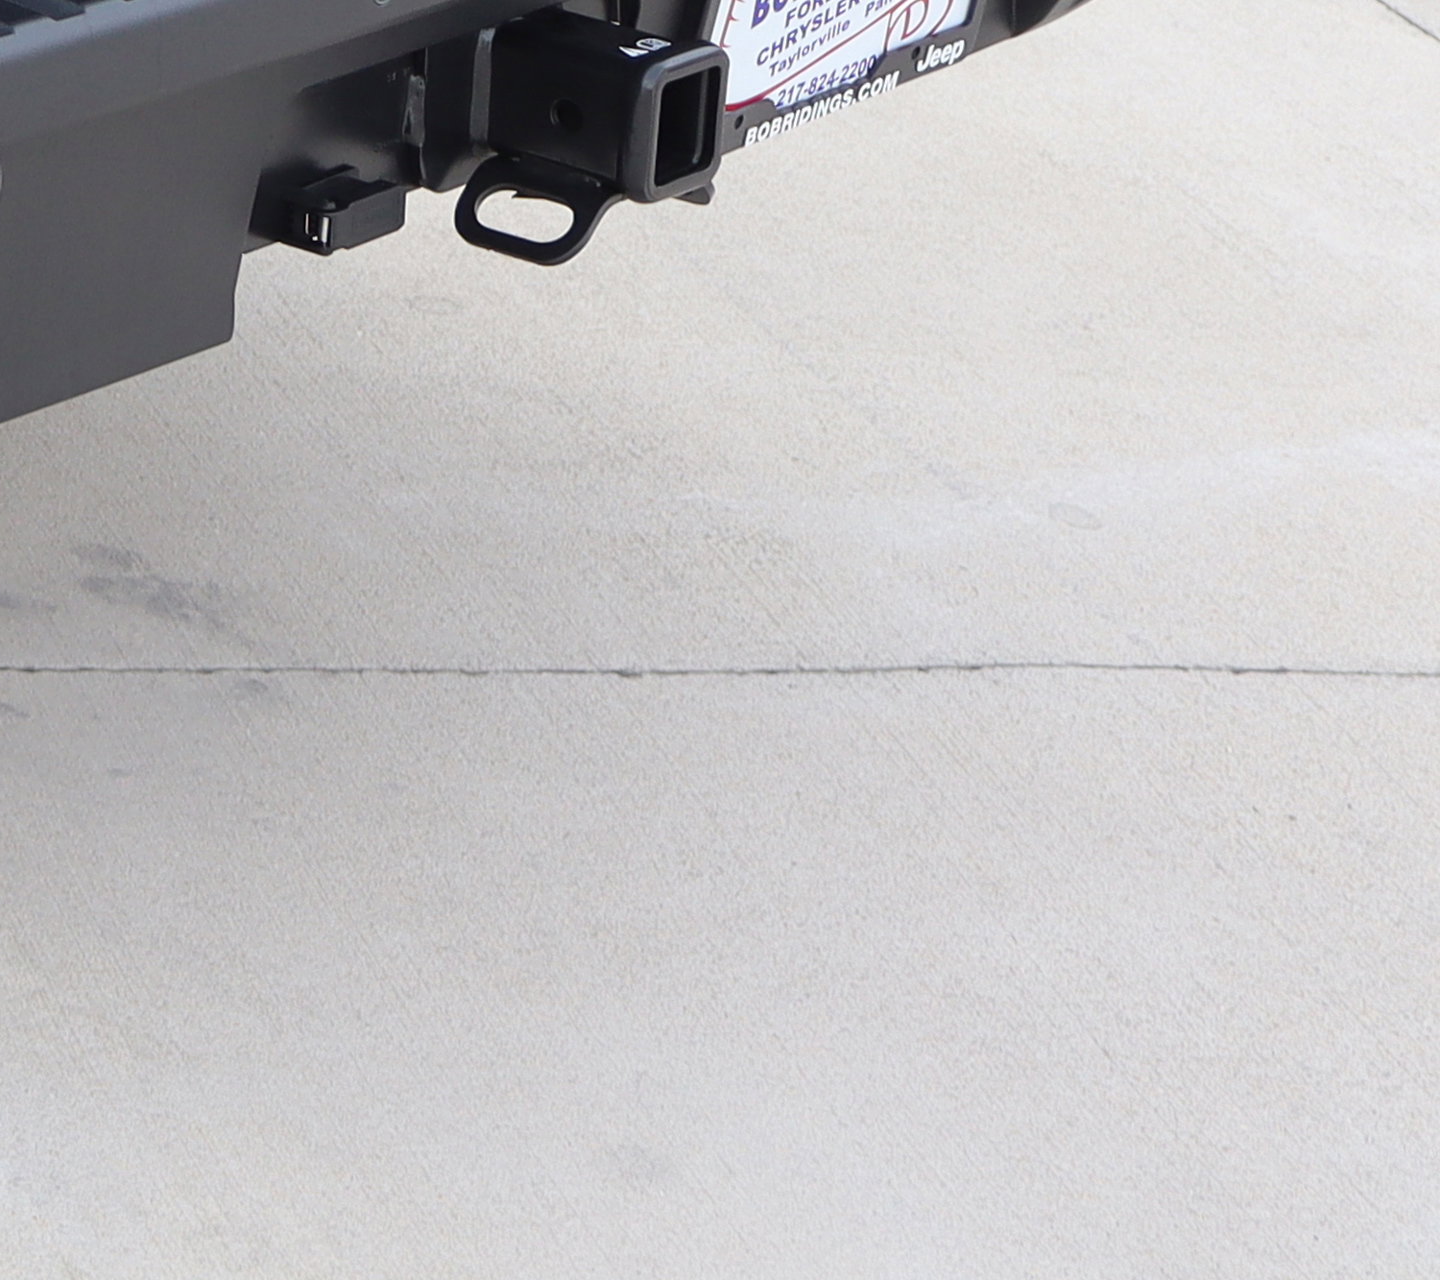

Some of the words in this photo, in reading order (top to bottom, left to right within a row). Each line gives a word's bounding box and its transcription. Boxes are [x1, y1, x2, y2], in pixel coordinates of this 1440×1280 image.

[768, 17, 851, 78] Taylorville
[916, 38, 966, 73] Jeep
[744, 70, 901, 148] BOBRIDINGS.COM
[775, 54, 878, 108] 217-824-2200
